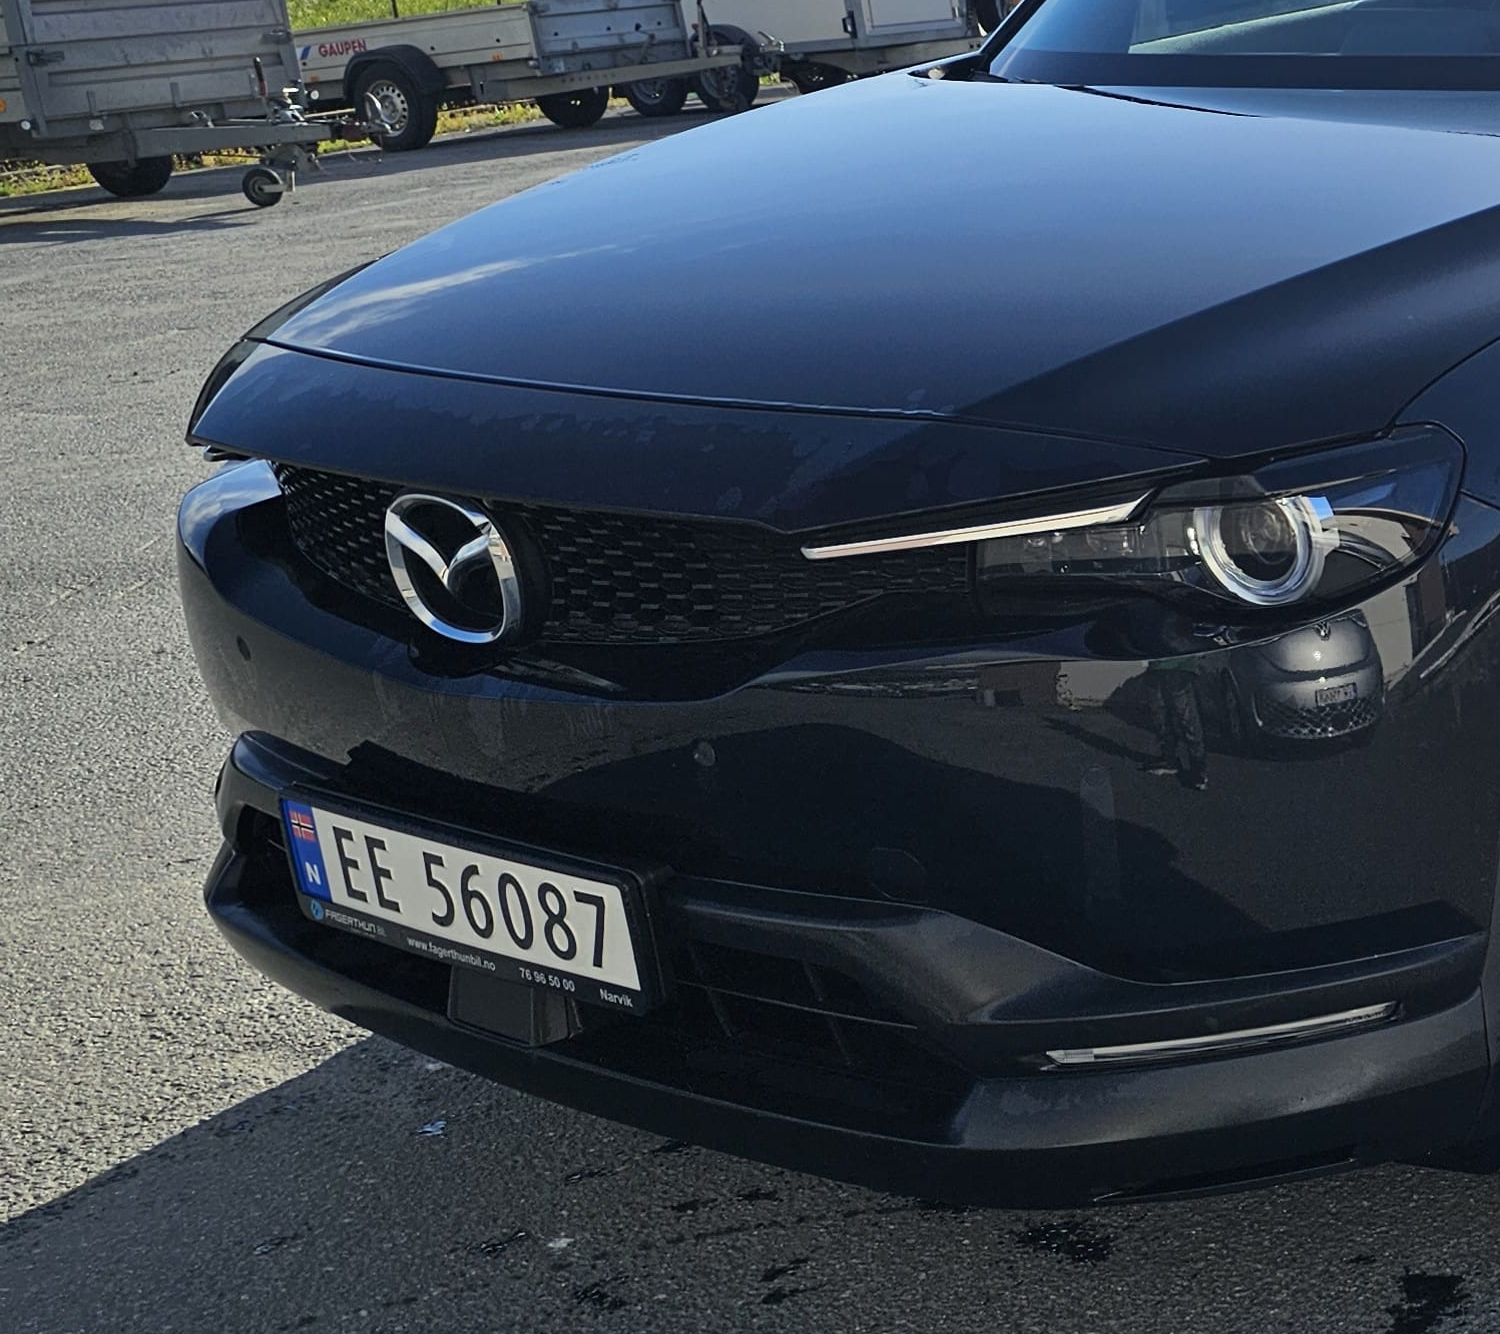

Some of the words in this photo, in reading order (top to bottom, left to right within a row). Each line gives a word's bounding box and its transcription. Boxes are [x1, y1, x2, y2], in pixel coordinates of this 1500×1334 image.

[318, 38, 368, 57] GAUPEN
[304, 861, 322, 886] N
[332, 825, 401, 913] EE
[422, 850, 606, 969] 56087
[518, 967, 532, 980] 76
[548, 975, 561, 989] 50
[562, 978, 577, 993] 00
[599, 988, 634, 1008] Narvik
